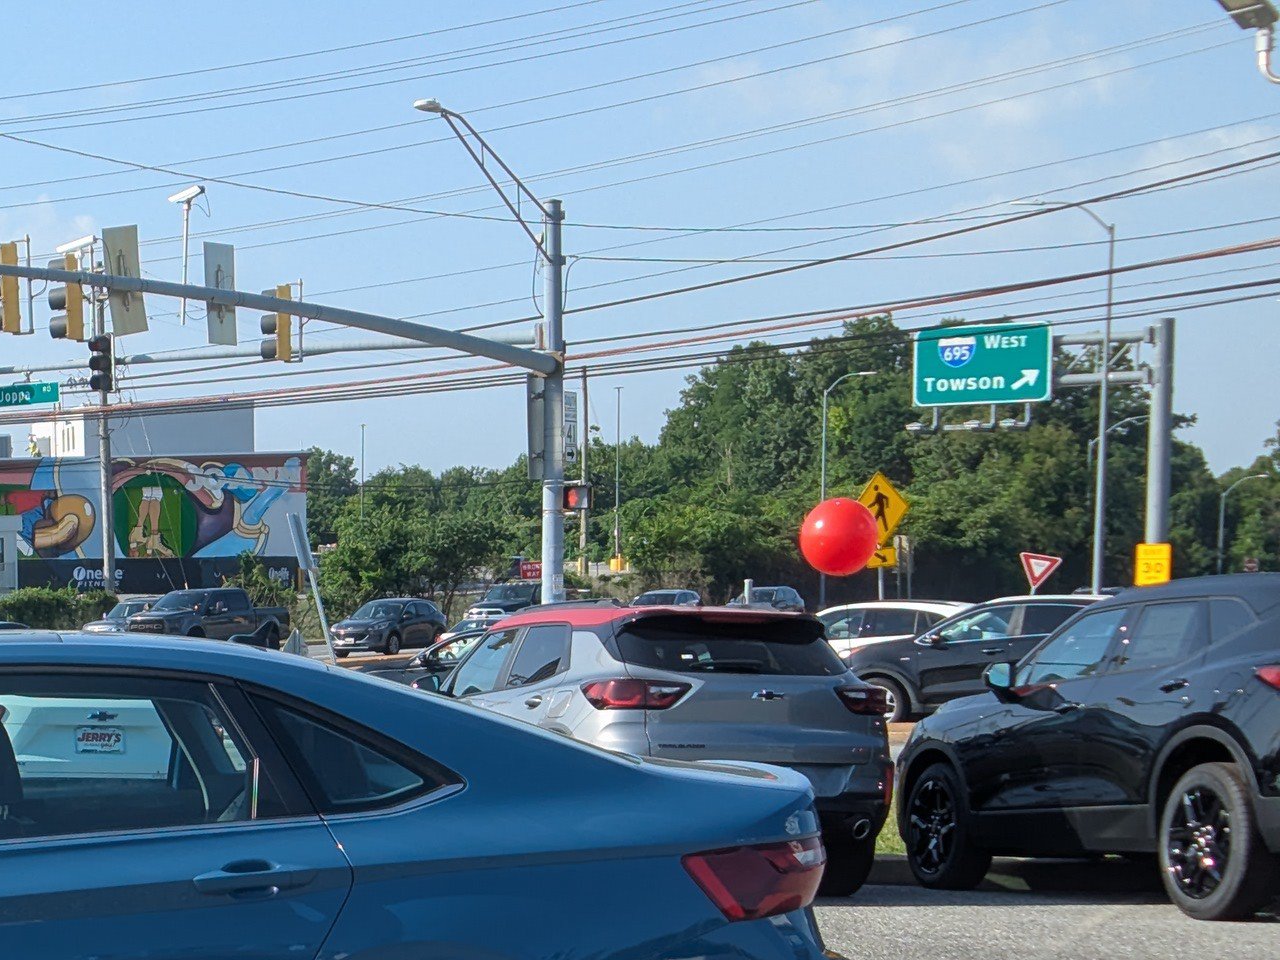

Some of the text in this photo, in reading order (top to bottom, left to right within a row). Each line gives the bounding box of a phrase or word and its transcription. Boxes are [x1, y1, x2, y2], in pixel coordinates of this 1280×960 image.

[984, 334, 1028, 349] WEST
[943, 346, 970, 361] 695
[923, 376, 1005, 392] Towson
[73, 566, 123, 581] Onee
[1142, 562, 1163, 573] 30
[77, 732, 121, 742] JERRY'S
